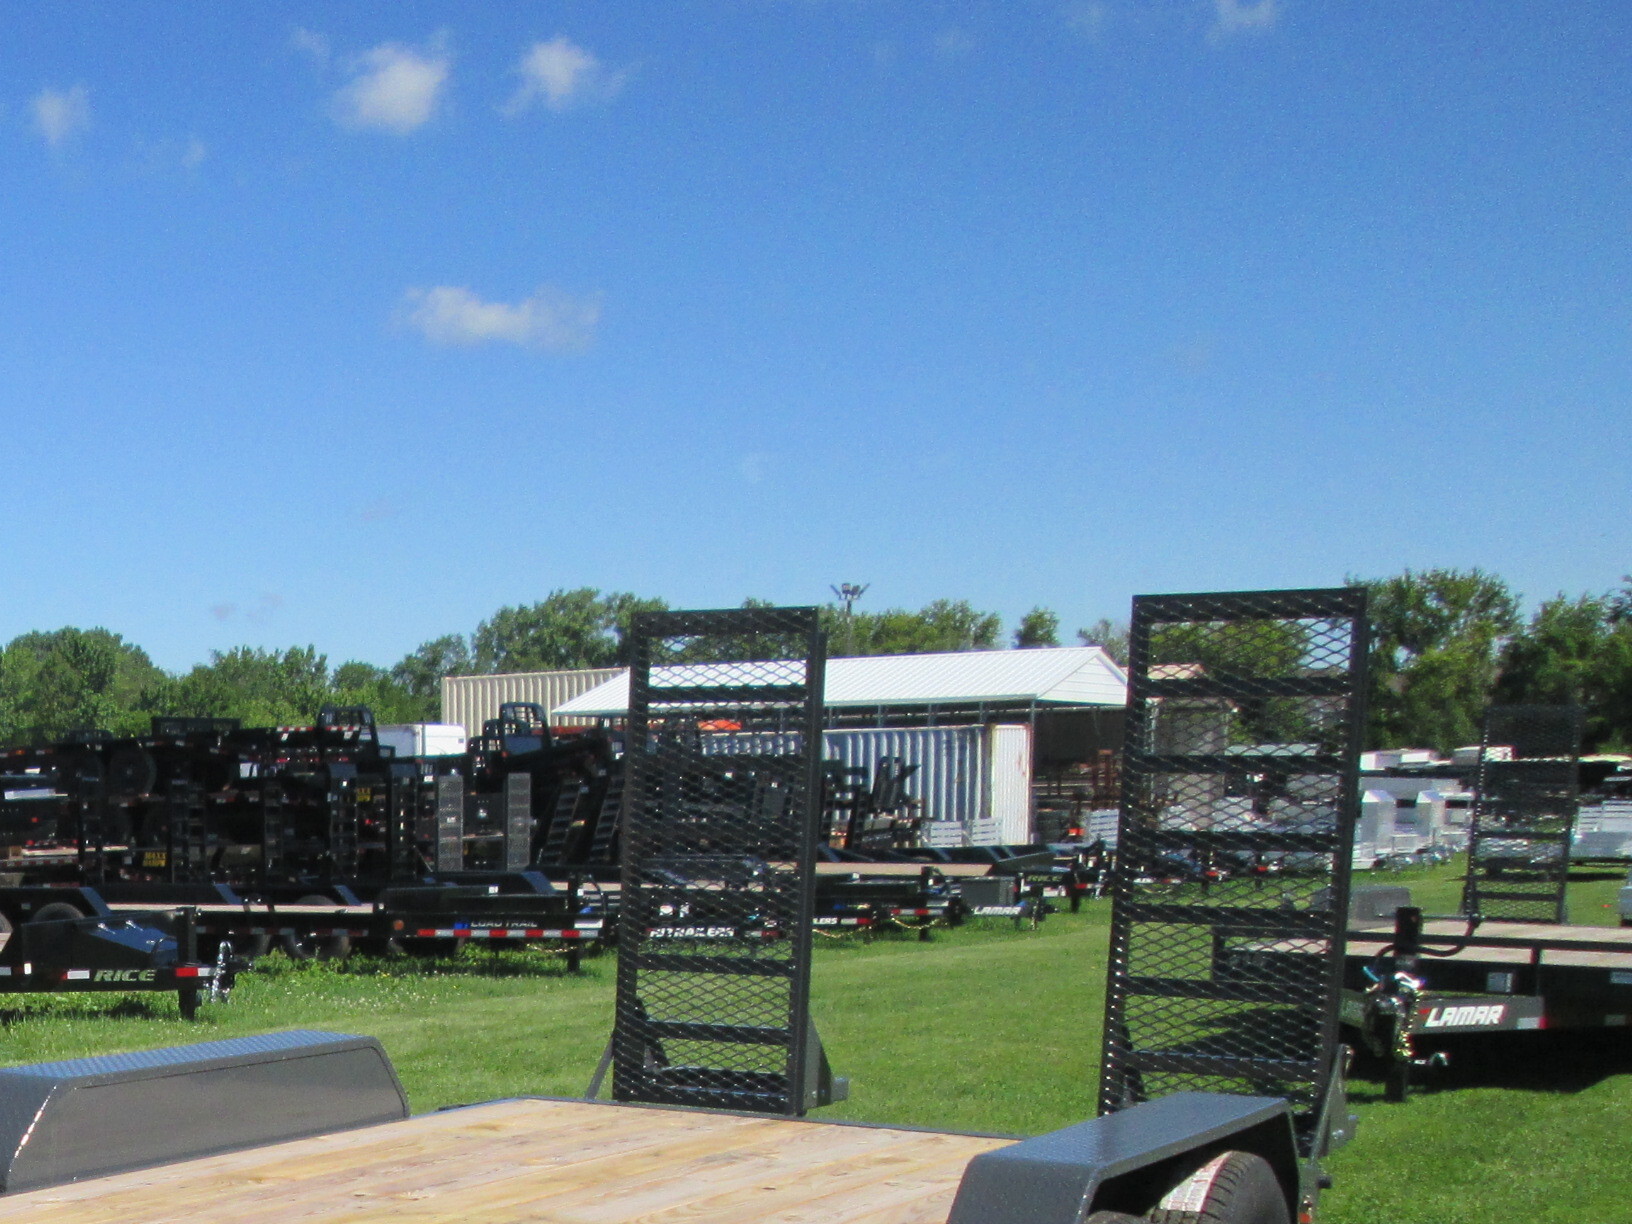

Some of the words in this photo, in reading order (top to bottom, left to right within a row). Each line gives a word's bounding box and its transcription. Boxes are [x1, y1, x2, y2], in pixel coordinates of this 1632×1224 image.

[974, 906, 1022, 916] LAMAR
[93, 969, 157, 982] RICE
[1424, 1004, 1505, 1028] LAMAR
